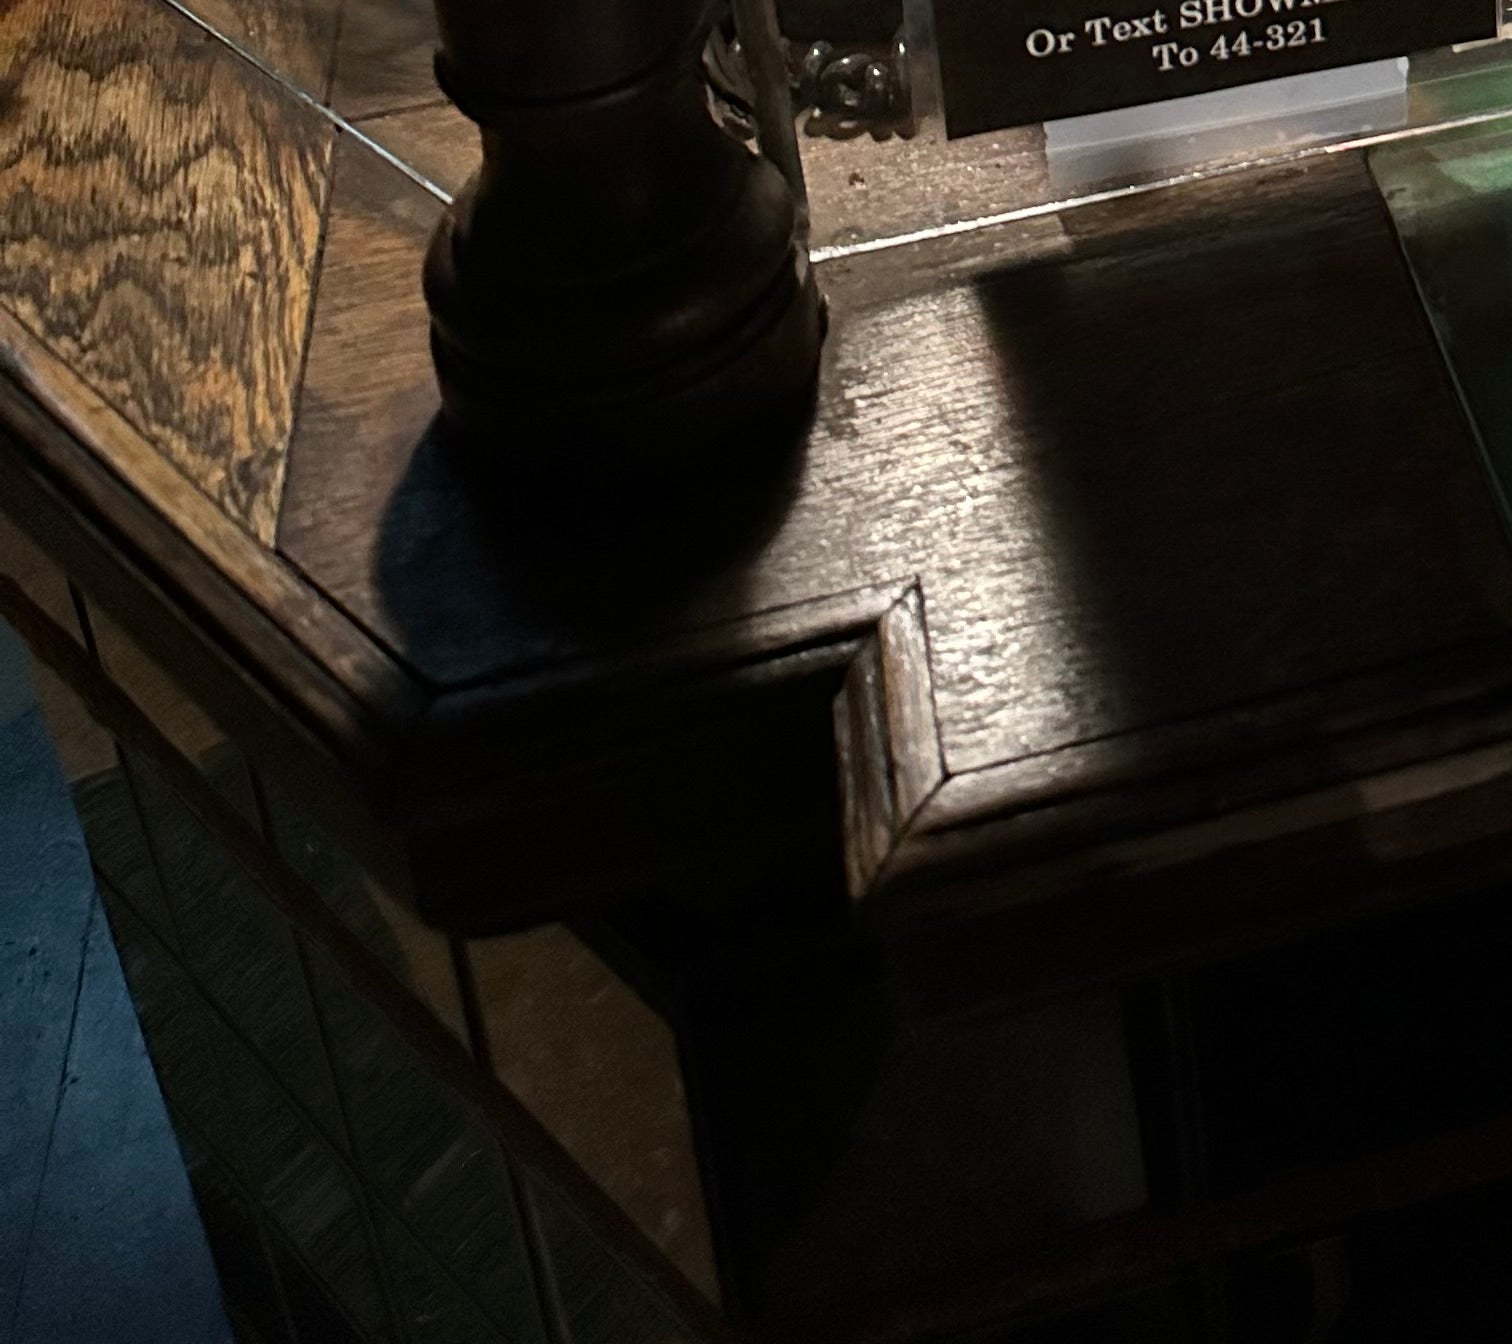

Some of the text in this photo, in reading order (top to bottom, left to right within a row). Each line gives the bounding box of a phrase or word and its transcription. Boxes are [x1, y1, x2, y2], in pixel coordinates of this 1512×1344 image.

[1026, 28, 1075, 57] Or
[1085, 9, 1168, 46] Text
[1153, 17, 1327, 71] To 44-321
